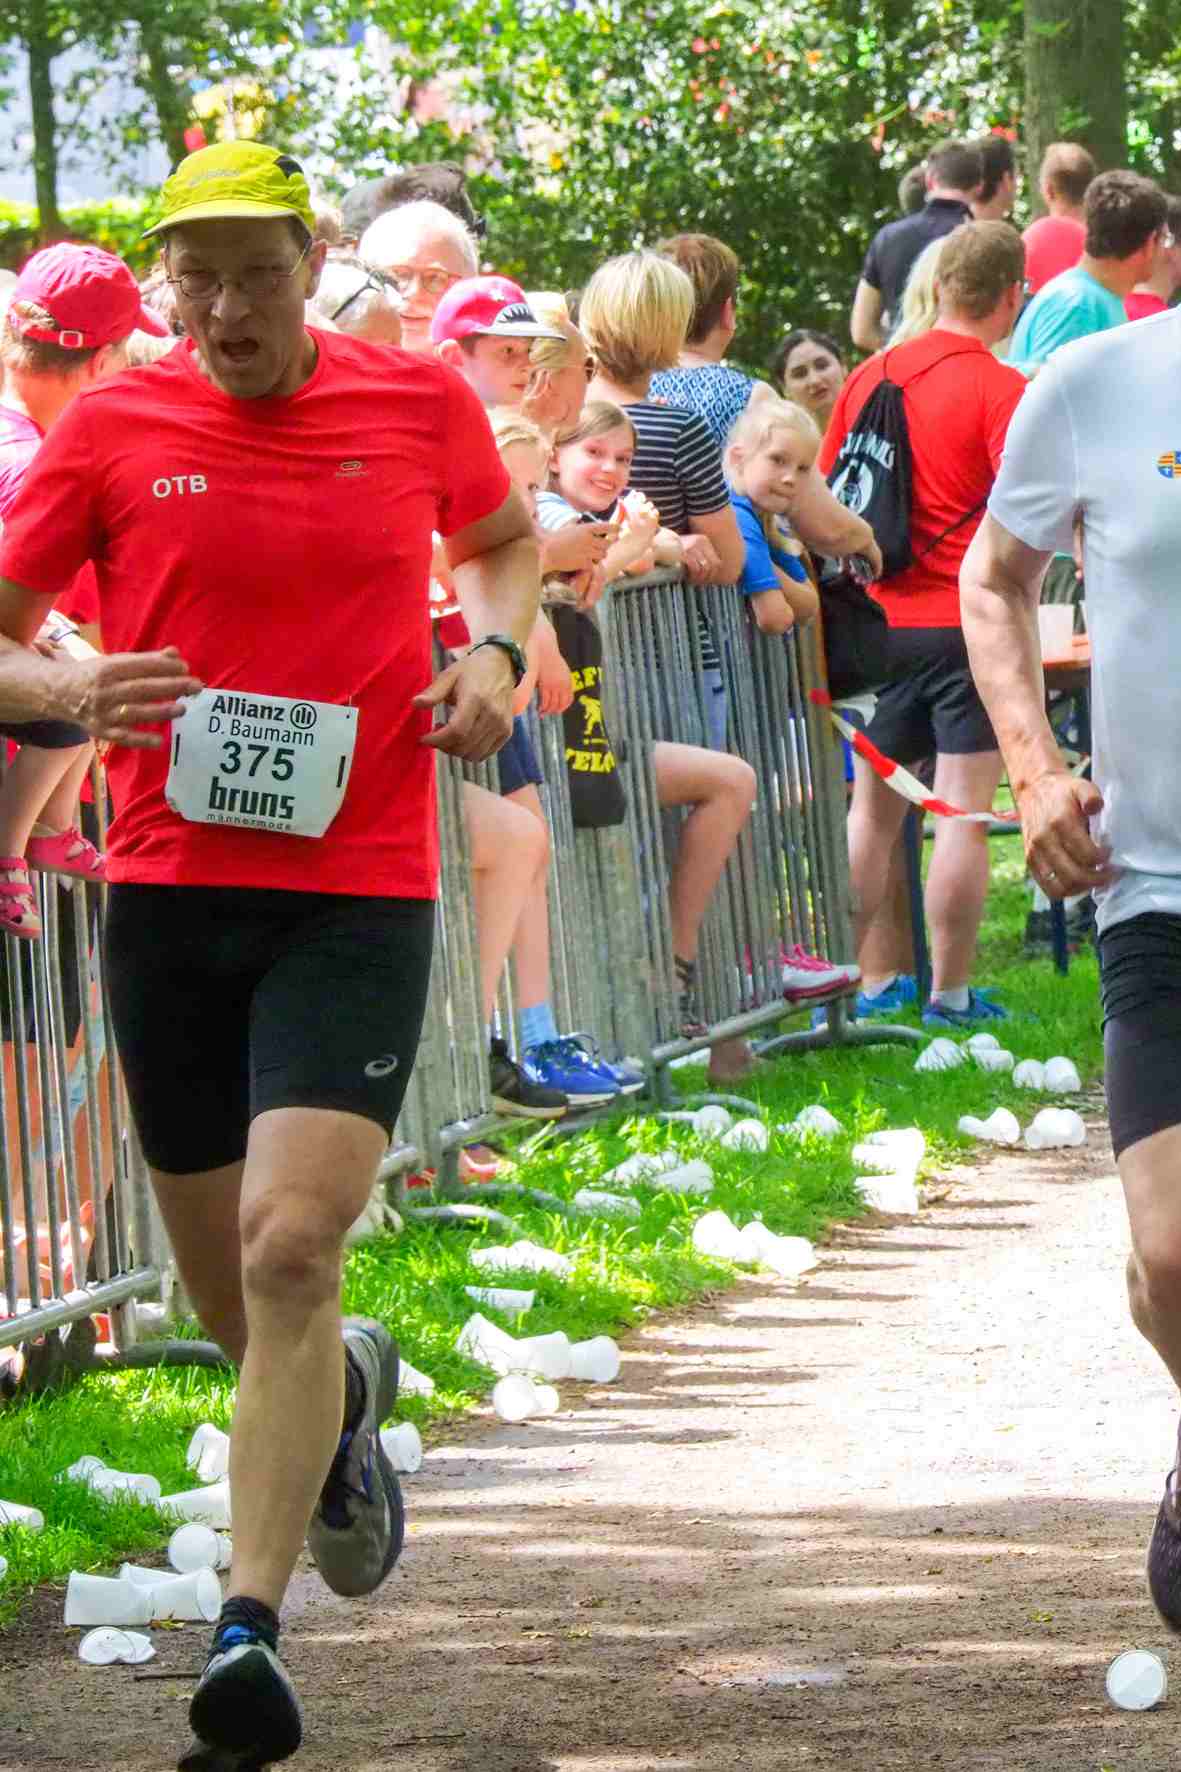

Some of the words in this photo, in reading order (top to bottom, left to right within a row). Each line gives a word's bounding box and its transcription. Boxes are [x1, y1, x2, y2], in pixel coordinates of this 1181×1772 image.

[152, 474, 208, 499] OTB
[211, 695, 285, 722] Allianz
[208, 715, 225, 734] D.
[230, 718, 315, 747] Baumann
[219, 740, 296, 782] 375
[208, 776, 296, 820] bruns
